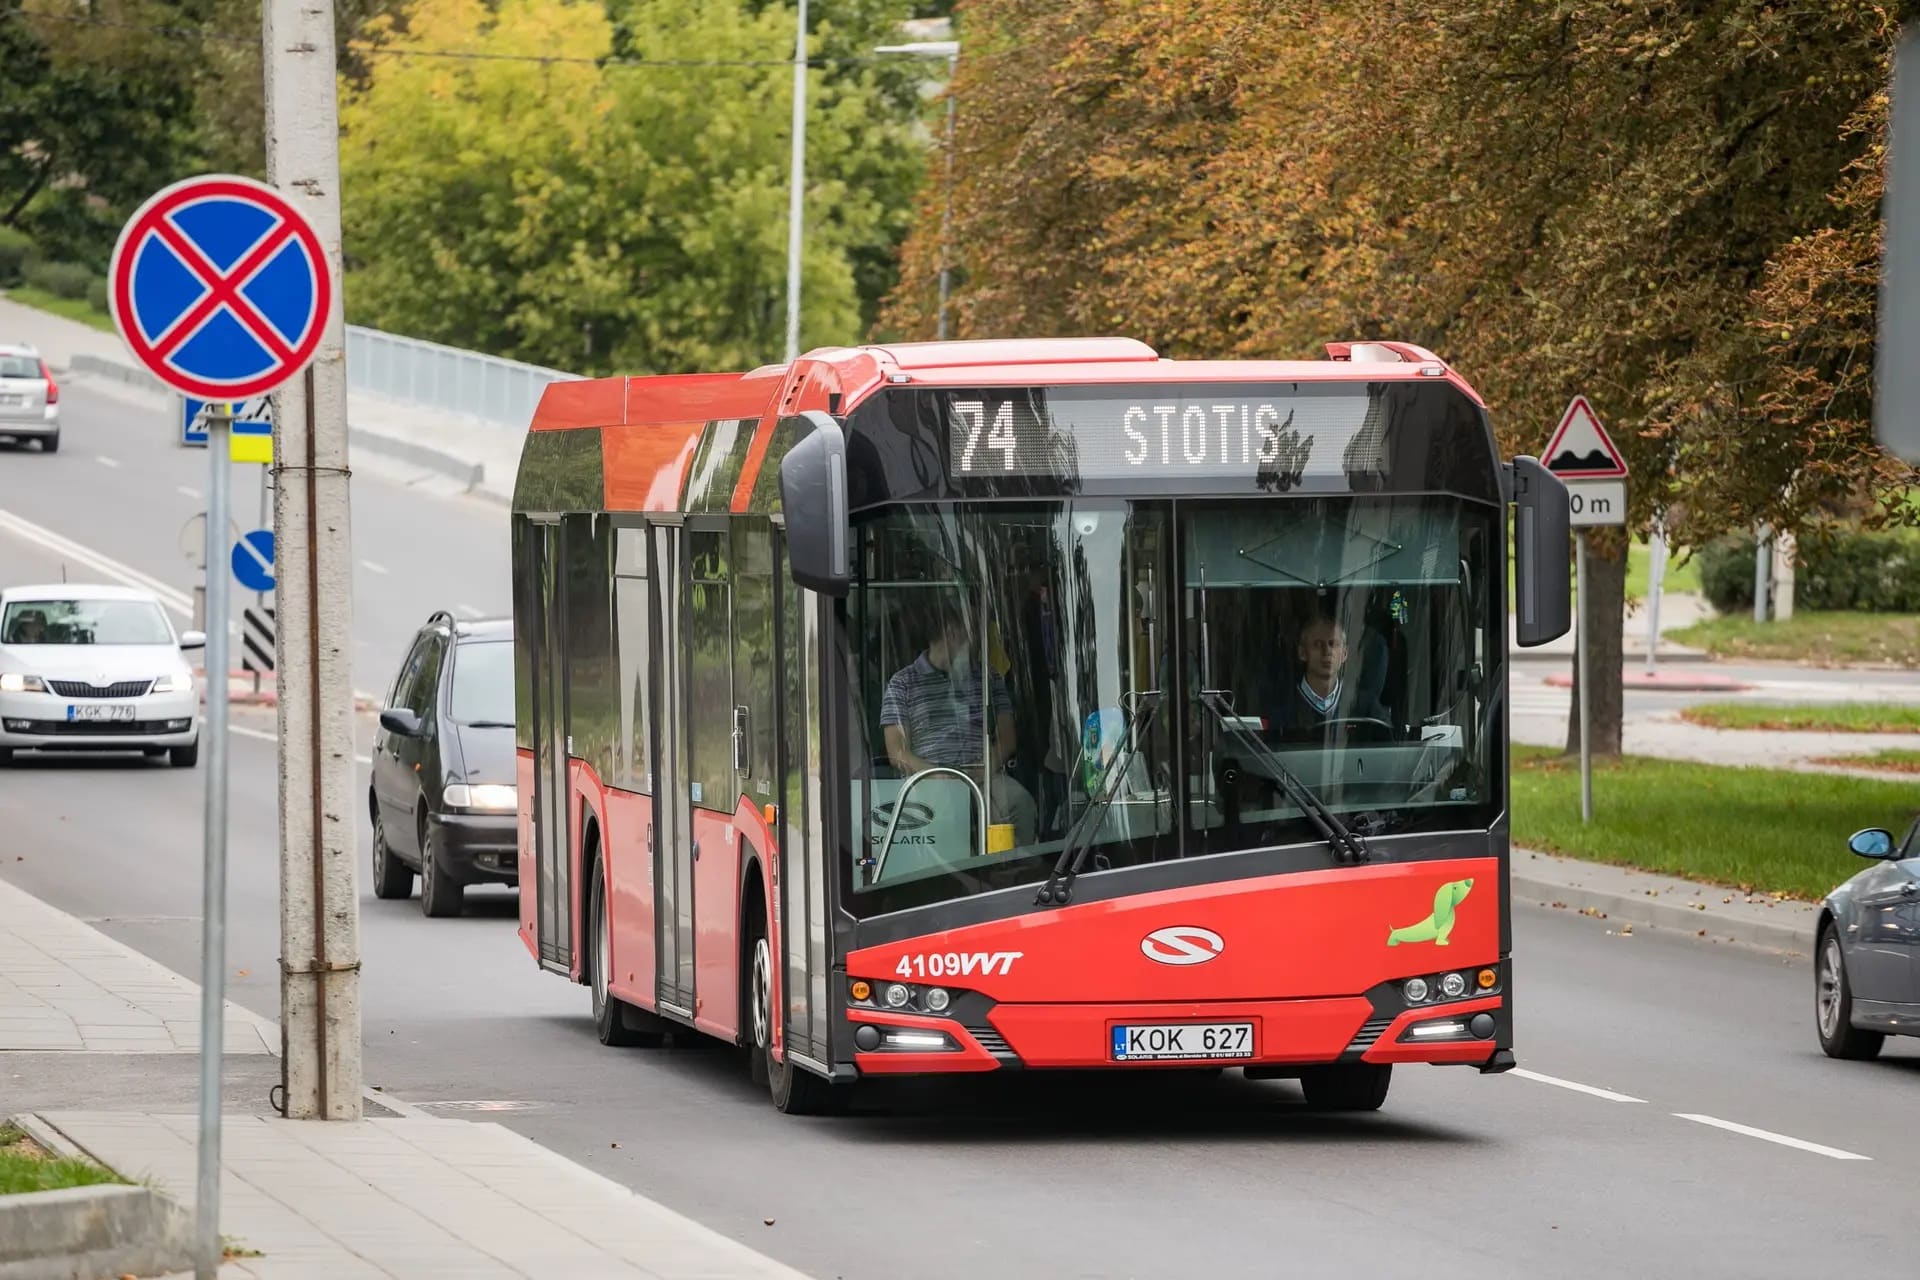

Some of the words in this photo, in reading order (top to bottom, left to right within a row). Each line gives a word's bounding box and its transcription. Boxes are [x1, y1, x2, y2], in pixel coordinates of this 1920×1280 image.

[955, 401, 1017, 471] 74
[1123, 404, 1278, 465] STOTIS
[1570, 494, 1583, 514] 0
[1590, 498, 1610, 513] m
[111, 705, 133, 718] 776
[1115, 1043, 1126, 1051] LT
[1130, 1028, 1184, 1052] KOK
[1203, 1027, 1248, 1050] 627
